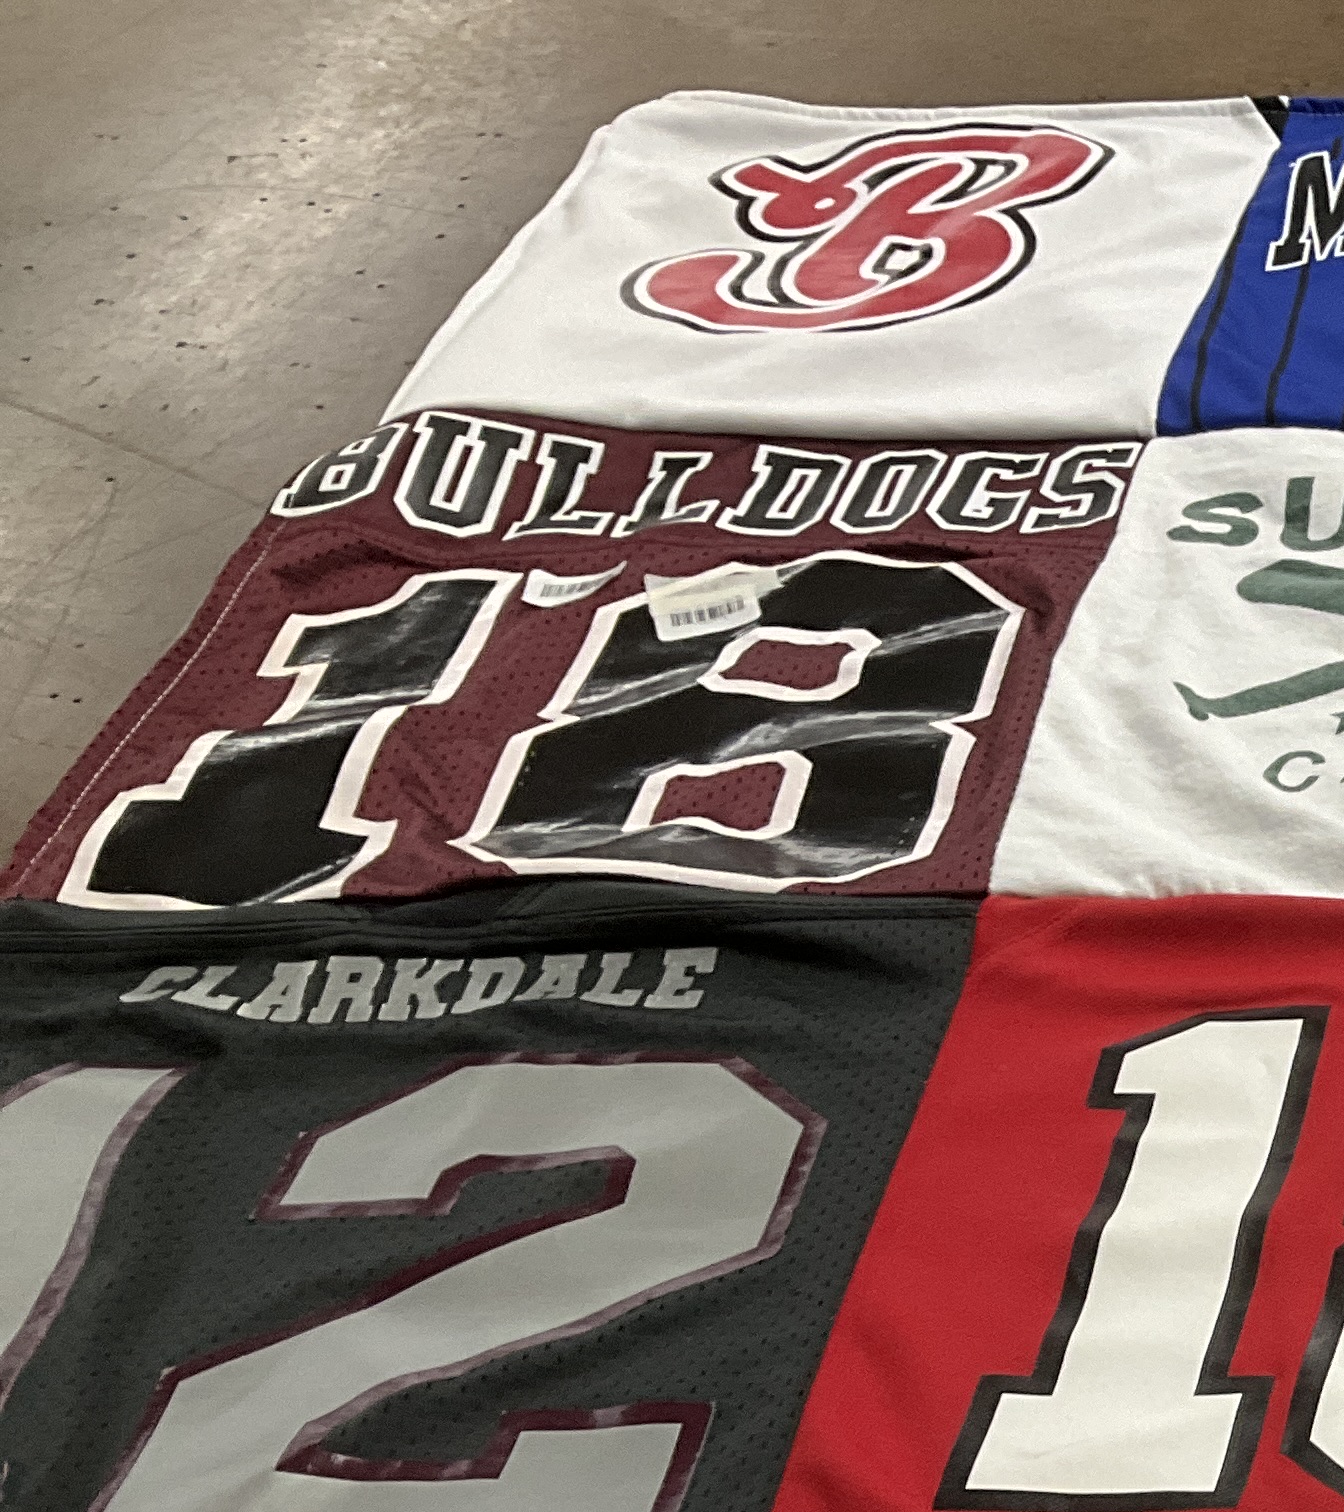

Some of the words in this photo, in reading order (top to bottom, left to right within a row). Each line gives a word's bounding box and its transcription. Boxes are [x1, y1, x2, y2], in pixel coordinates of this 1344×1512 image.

[270, 411, 1142, 538] BULLDOGS
[55, 550, 1025, 908] 18
[118, 946, 719, 1024] CLARKDALE
